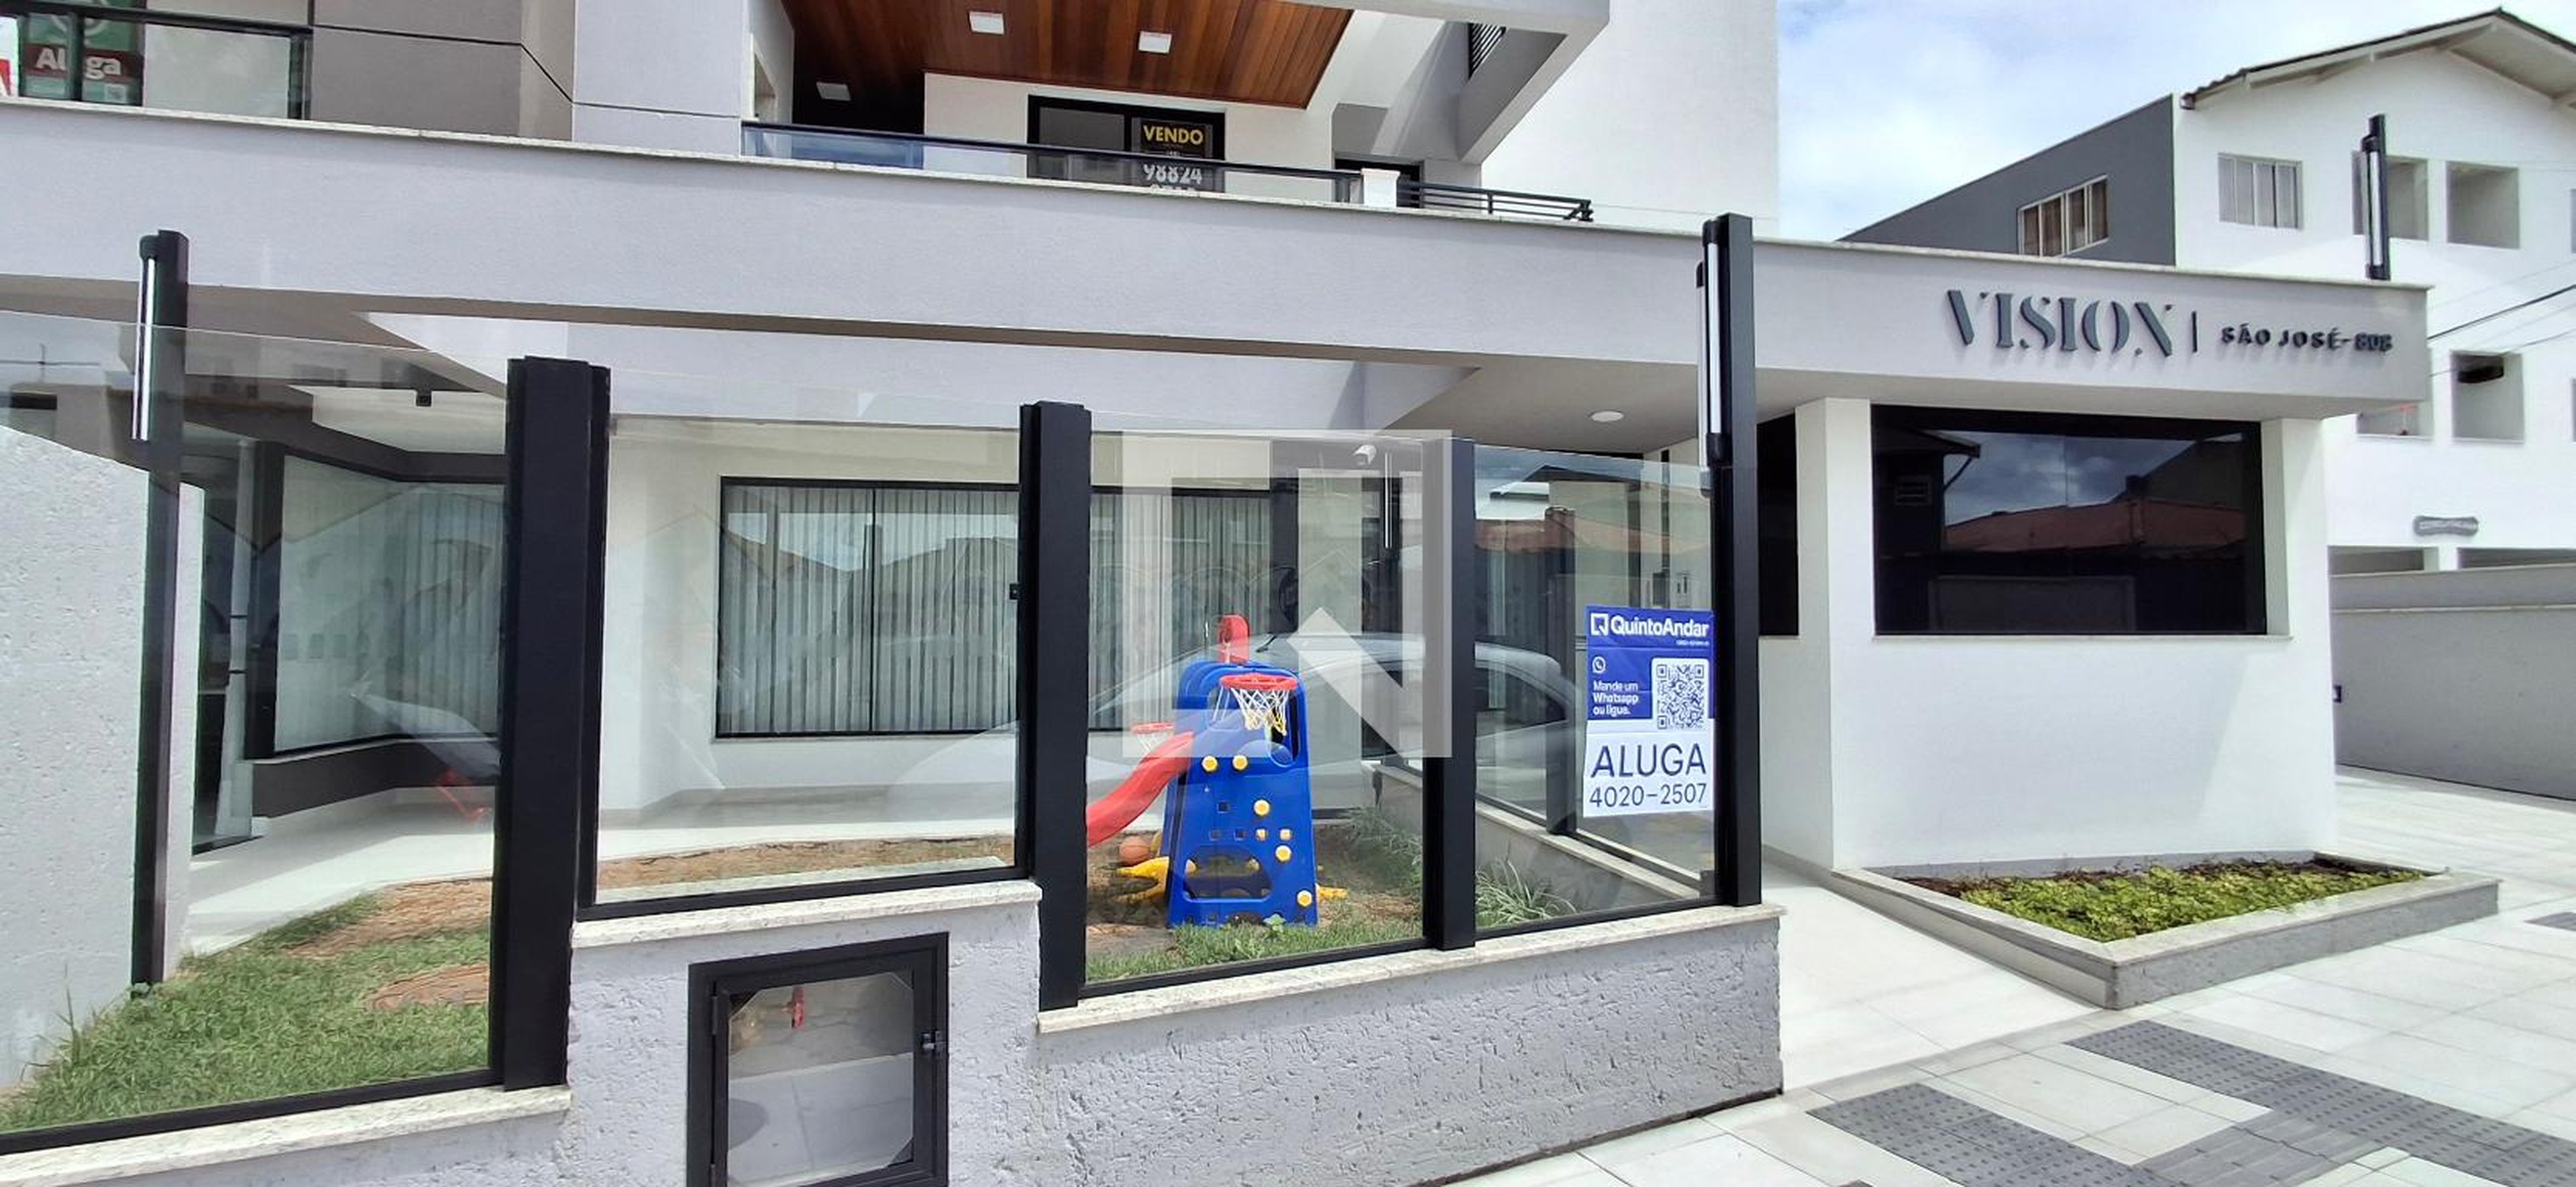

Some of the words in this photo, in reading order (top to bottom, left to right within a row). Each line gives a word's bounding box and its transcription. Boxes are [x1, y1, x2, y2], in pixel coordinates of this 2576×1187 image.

[36, 47, 122, 80] Alga
[1142, 125, 1203, 145] VENDO
[1945, 290, 2173, 357] VISION
[2220, 323, 2271, 345] SÃO
[1611, 615, 1709, 637] QuintoAndar
[1593, 681, 1624, 691] Mande
[1625, 683, 1639, 691] um
[1593, 692, 1640, 704] Whatsapp
[1593, 707, 1605, 715] ou
[1606, 705, 1631, 717] ligue.
[1590, 743, 1707, 778] ALUGA
[1589, 783, 1707, 807] 4020-2507
